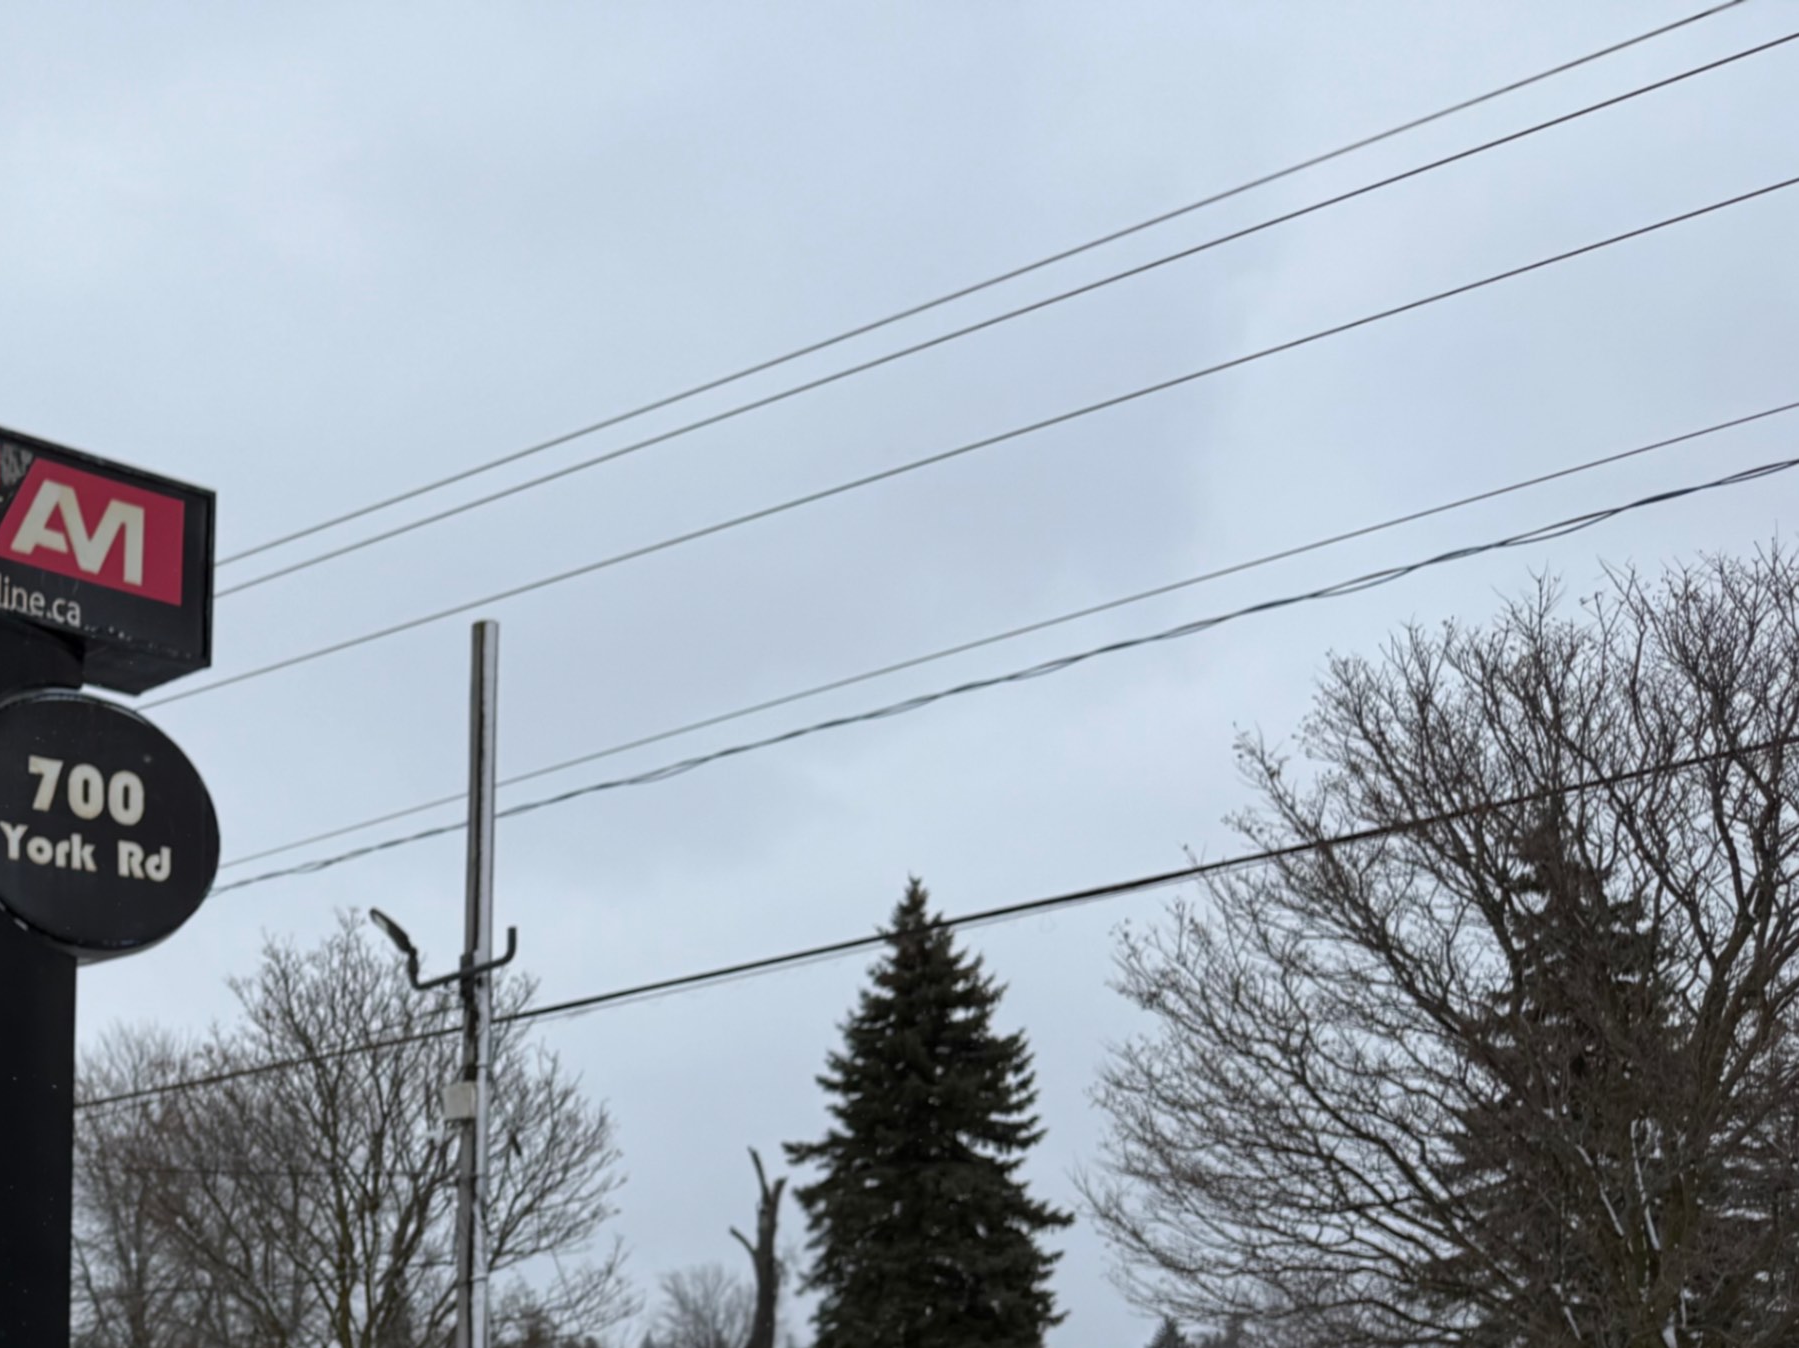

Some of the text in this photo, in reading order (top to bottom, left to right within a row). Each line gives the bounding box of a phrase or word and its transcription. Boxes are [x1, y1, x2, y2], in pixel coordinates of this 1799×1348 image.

[9, 479, 145, 587] AM
[28, 755, 145, 826] 700
[0, 821, 171, 882] York Rd
